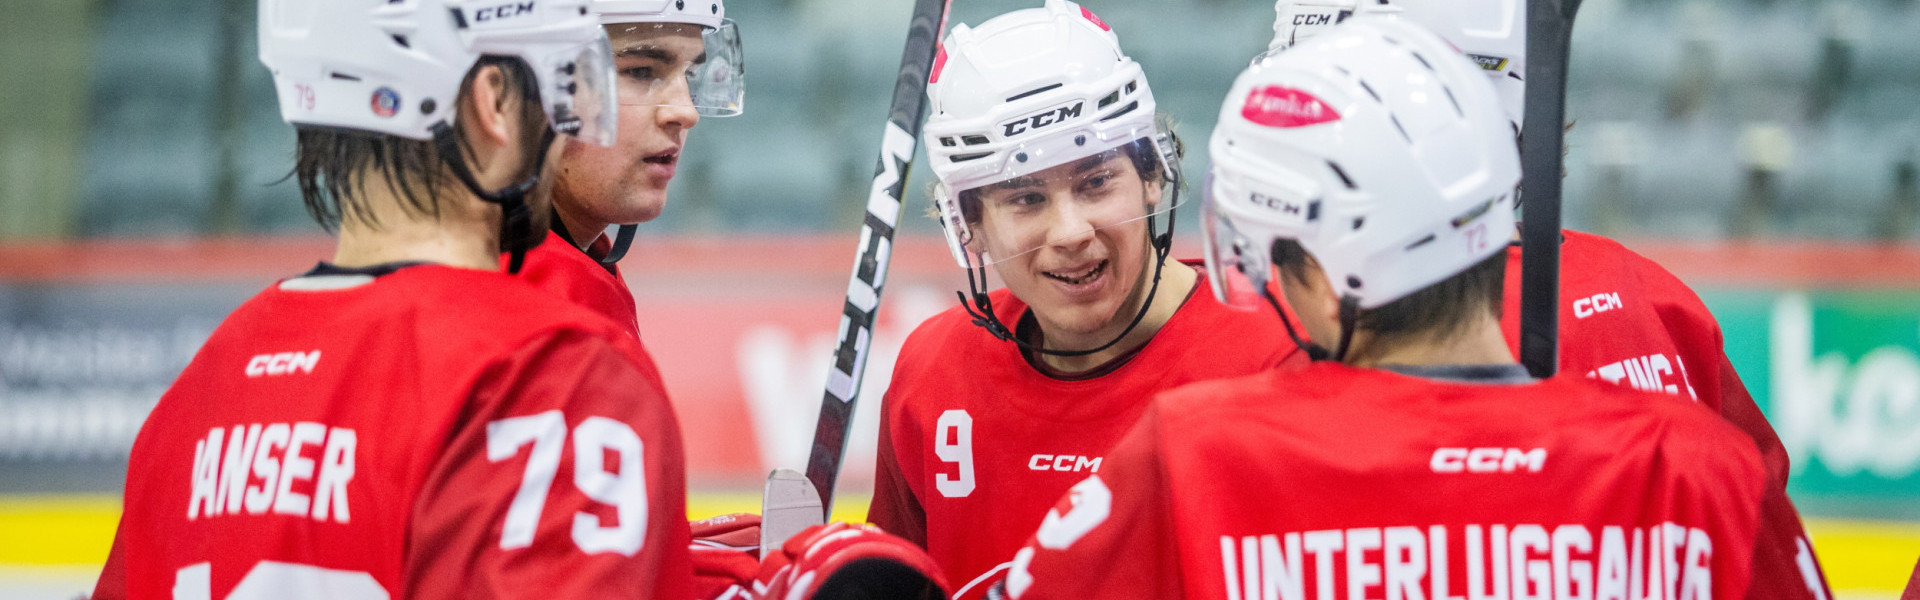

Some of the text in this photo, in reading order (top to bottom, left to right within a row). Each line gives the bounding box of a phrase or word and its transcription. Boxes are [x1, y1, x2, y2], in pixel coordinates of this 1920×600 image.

[474, 2, 534, 22] CCM
[1293, 14, 1331, 26] CCM
[1003, 101, 1083, 137] CCM
[825, 119, 916, 404] CCM
[1573, 291, 1623, 319] CCM
[245, 350, 321, 377] CCM
[934, 409, 976, 498] 9
[1028, 453, 1104, 473] CCM
[1430, 448, 1546, 473] CCM
[486, 409, 647, 558] 79
